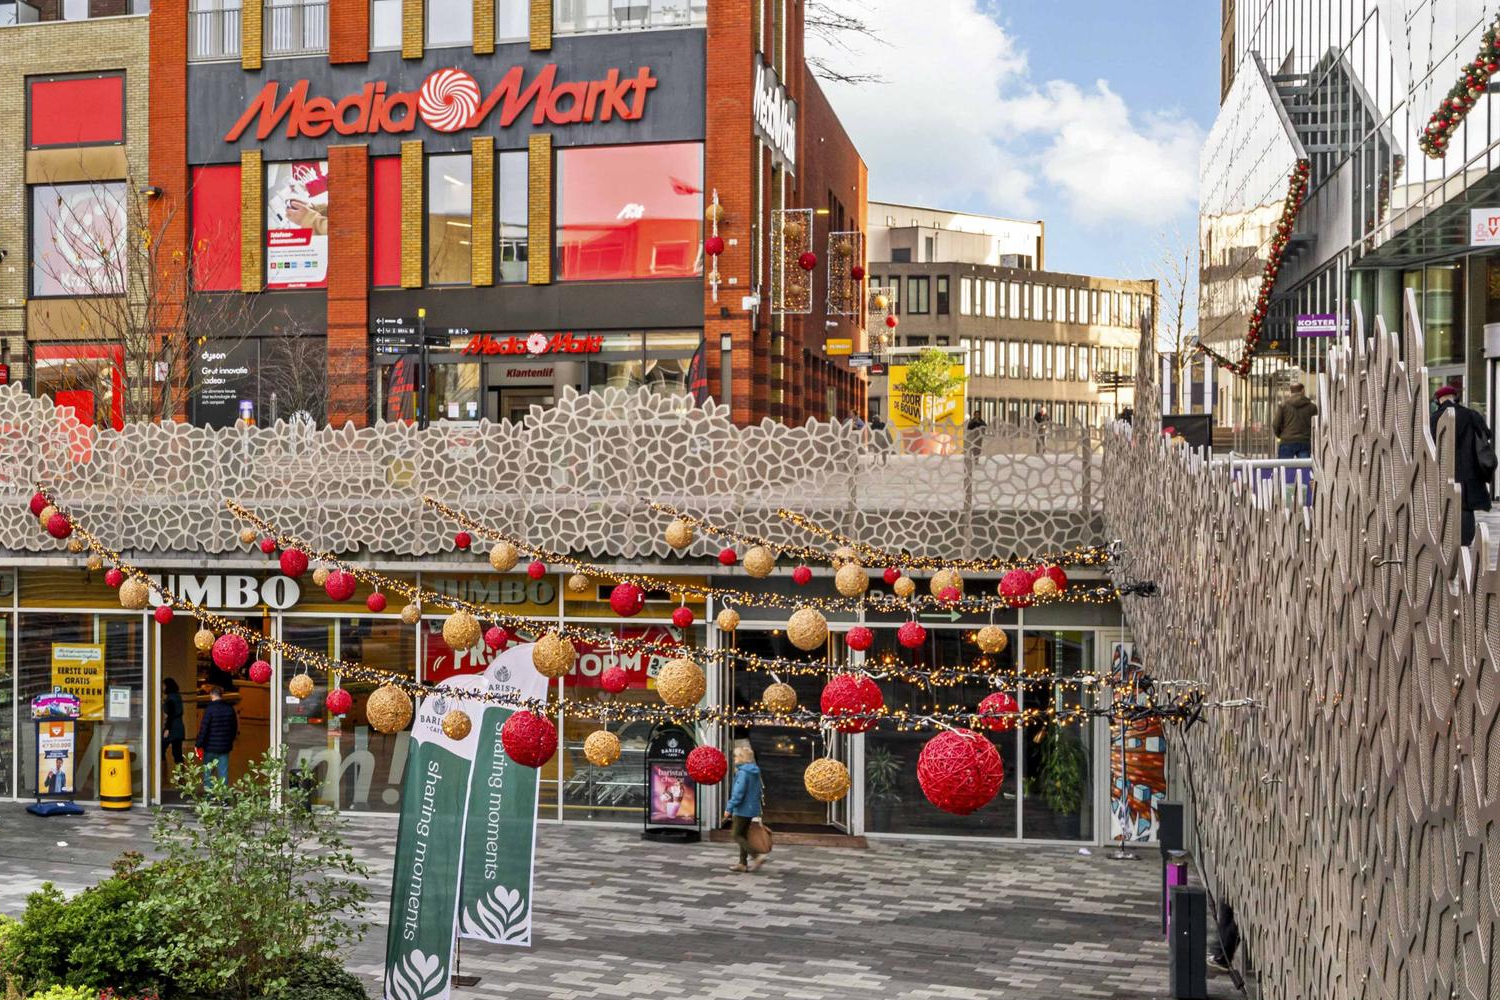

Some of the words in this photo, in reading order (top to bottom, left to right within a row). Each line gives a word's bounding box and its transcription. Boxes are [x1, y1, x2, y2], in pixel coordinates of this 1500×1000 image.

[224, 79, 419, 142] Media
[464, 64, 658, 128] Markt
[1297, 319, 1336, 327] KOSTER
[460, 332, 528, 356] Media
[201, 351, 226, 361] dyson
[506, 367, 555, 378] Klantenlif
[901, 392, 921, 407] DOOR
[146, 573, 301, 610] UMBO
[57, 667, 82, 675] EERSTE
[83, 667, 98, 675] UUR
[64, 677, 90, 685] GRATIS
[420, 714, 443, 726] BARI
[658, 768, 688, 776] barista's
[416, 760, 443, 838] sharing
[484, 792, 502, 881] moments
[403, 842, 428, 941] moments
